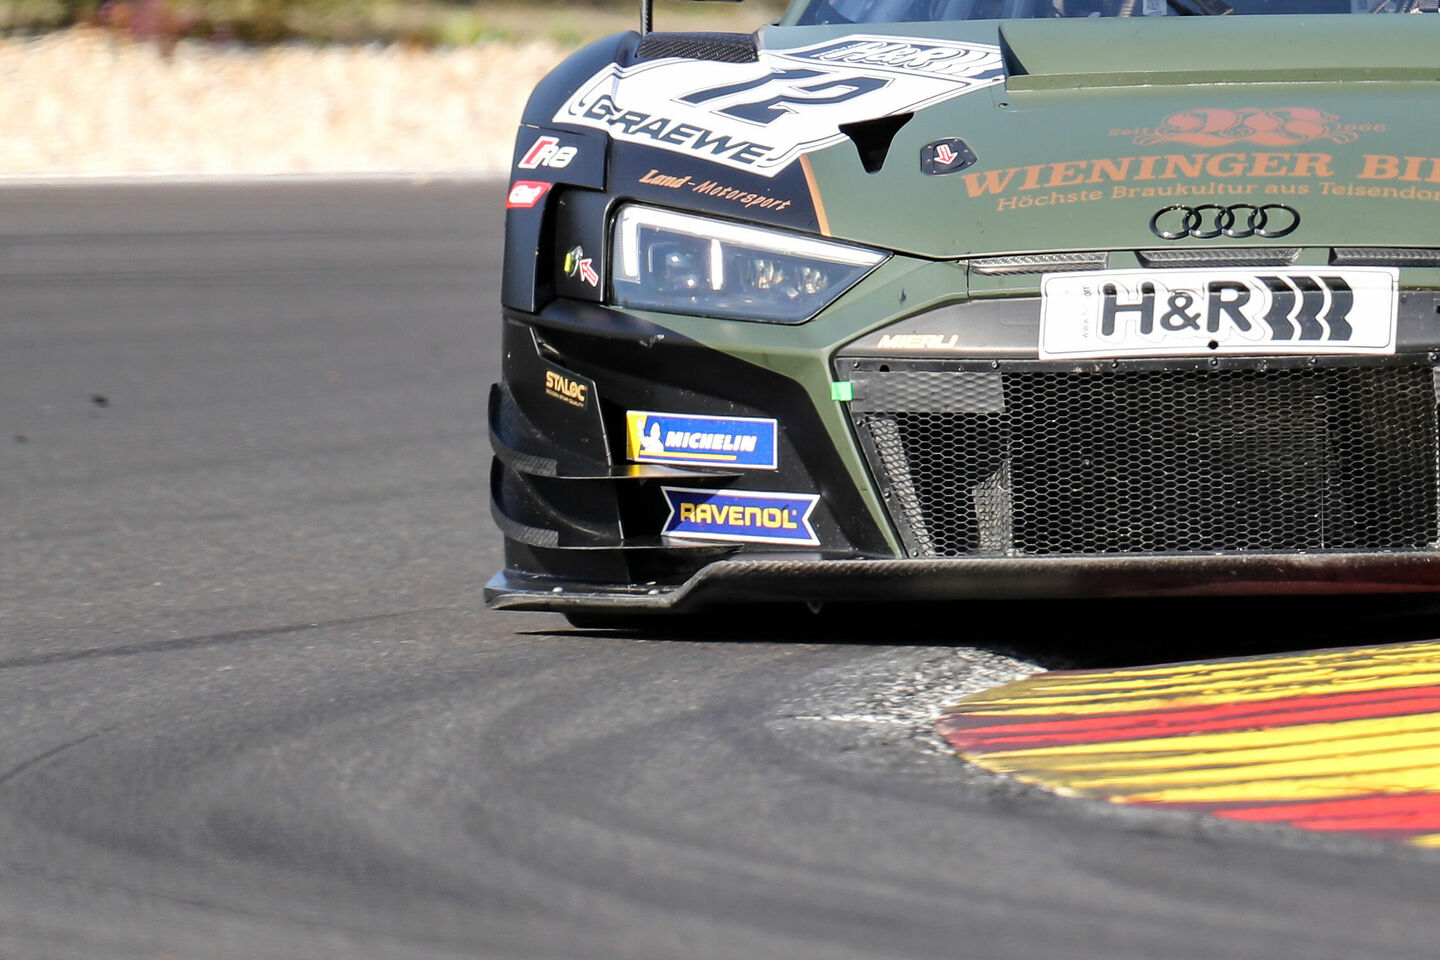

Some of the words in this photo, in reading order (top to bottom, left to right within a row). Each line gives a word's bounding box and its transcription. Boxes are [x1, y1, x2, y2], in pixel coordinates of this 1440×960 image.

[582, 94, 774, 164] GRAEWE
[522, 139, 578, 169] R8
[961, 152, 1335, 198] WIENINGER
[997, 189, 1102, 211] Höchste
[1111, 182, 1259, 199] Braukultur
[1264, 184, 1310, 195] aus
[1101, 280, 1252, 337] H&R
[545, 370, 586, 402] STALOC
[664, 431, 758, 452] MICHELIN
[679, 502, 799, 530] RAVENOL
